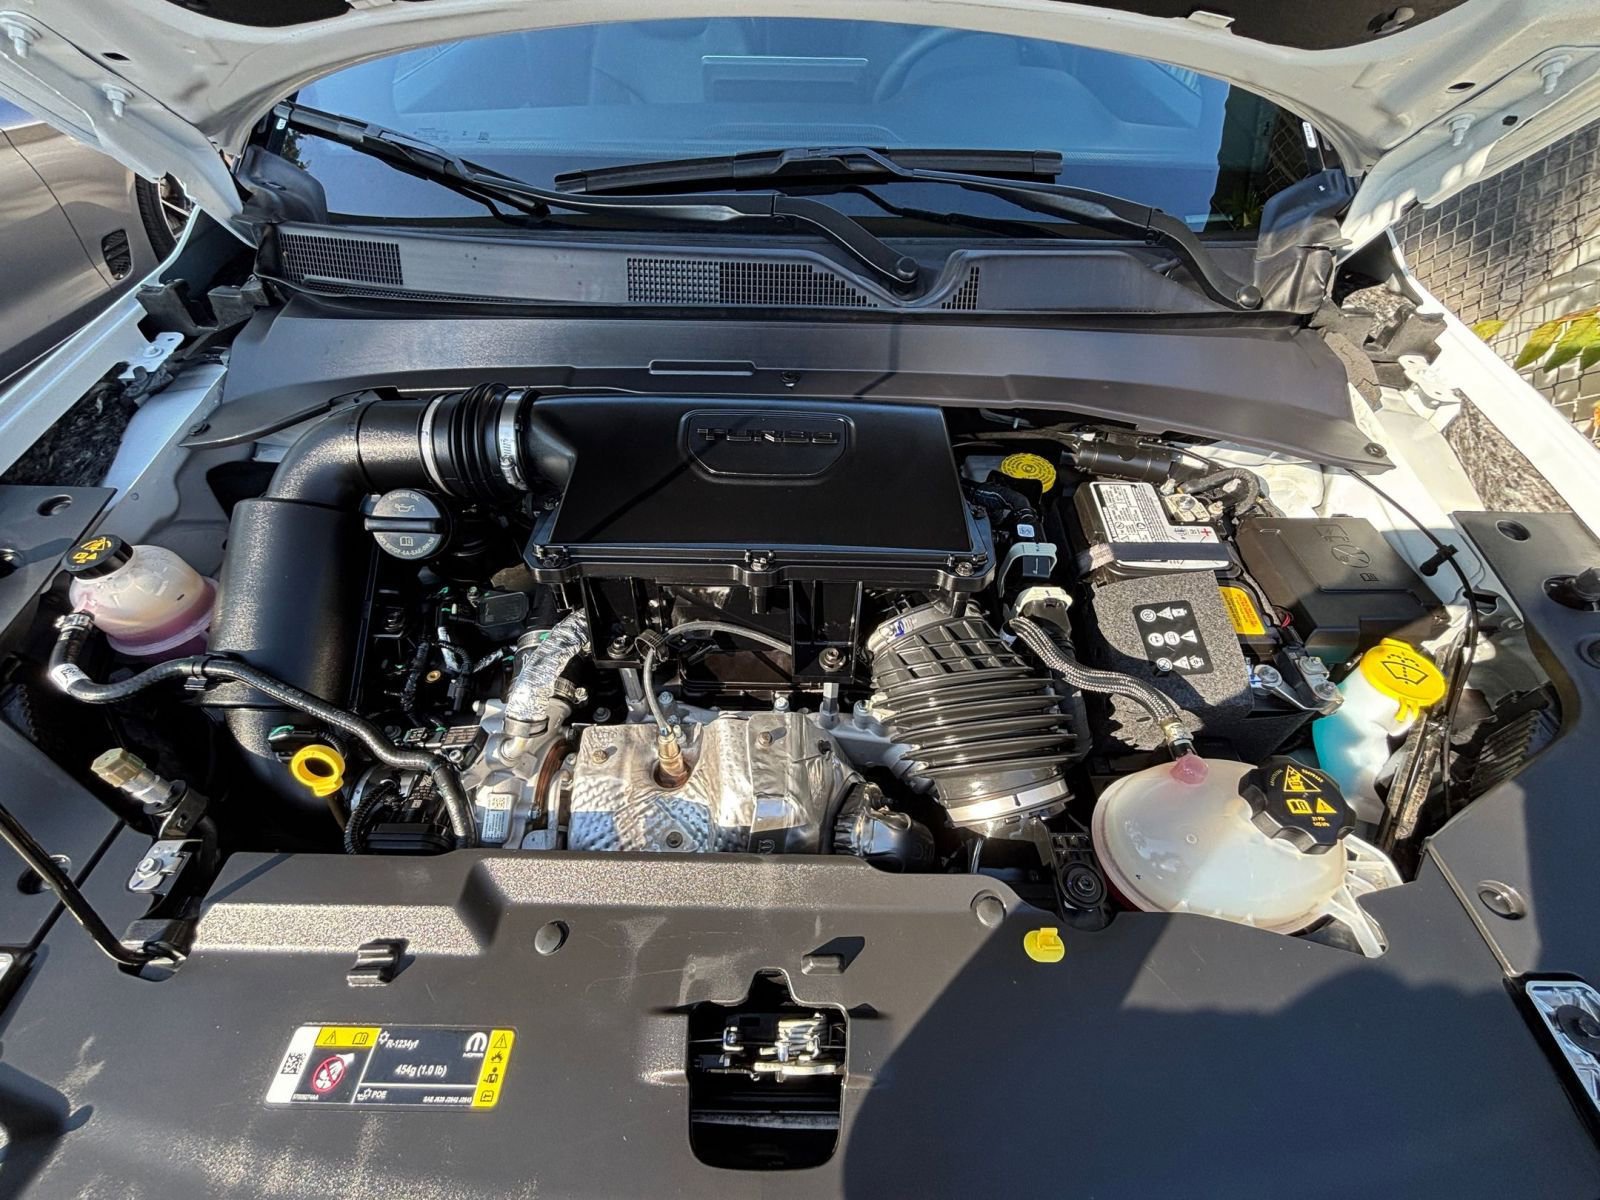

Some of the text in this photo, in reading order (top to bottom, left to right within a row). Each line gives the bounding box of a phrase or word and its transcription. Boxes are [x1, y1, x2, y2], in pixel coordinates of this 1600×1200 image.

[388, 492, 421, 502] ENGINE OIL
[385, 1039, 419, 1050] R-1234yf
[395, 1065, 417, 1078] 454g
[370, 1090, 388, 1100] POE
